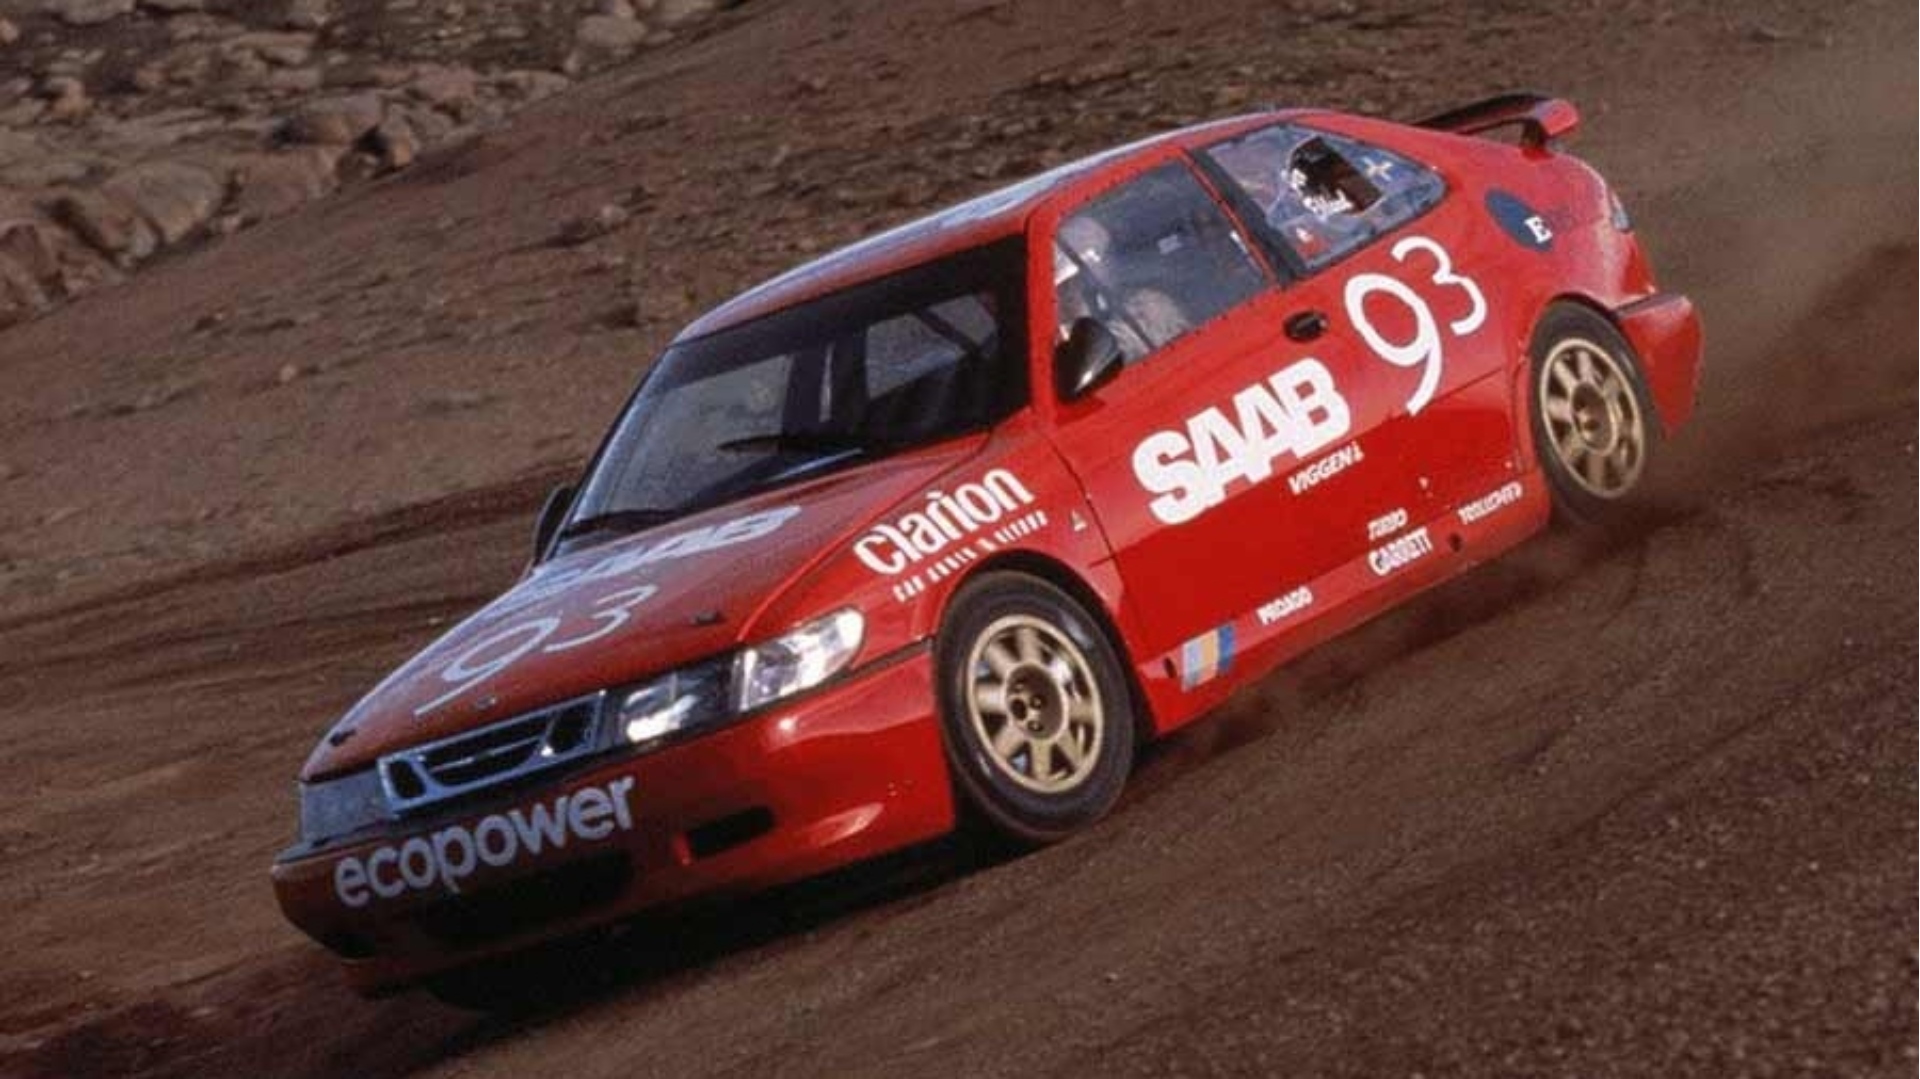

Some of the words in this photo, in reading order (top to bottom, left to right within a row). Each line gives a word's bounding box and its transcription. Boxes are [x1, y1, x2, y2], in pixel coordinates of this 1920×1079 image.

[1524, 215, 1553, 244] E
[1343, 235, 1488, 416] 93
[1132, 357, 1351, 525] SAAB
[853, 468, 1035, 575] Clarion
[334, 775, 636, 907] ecopower
